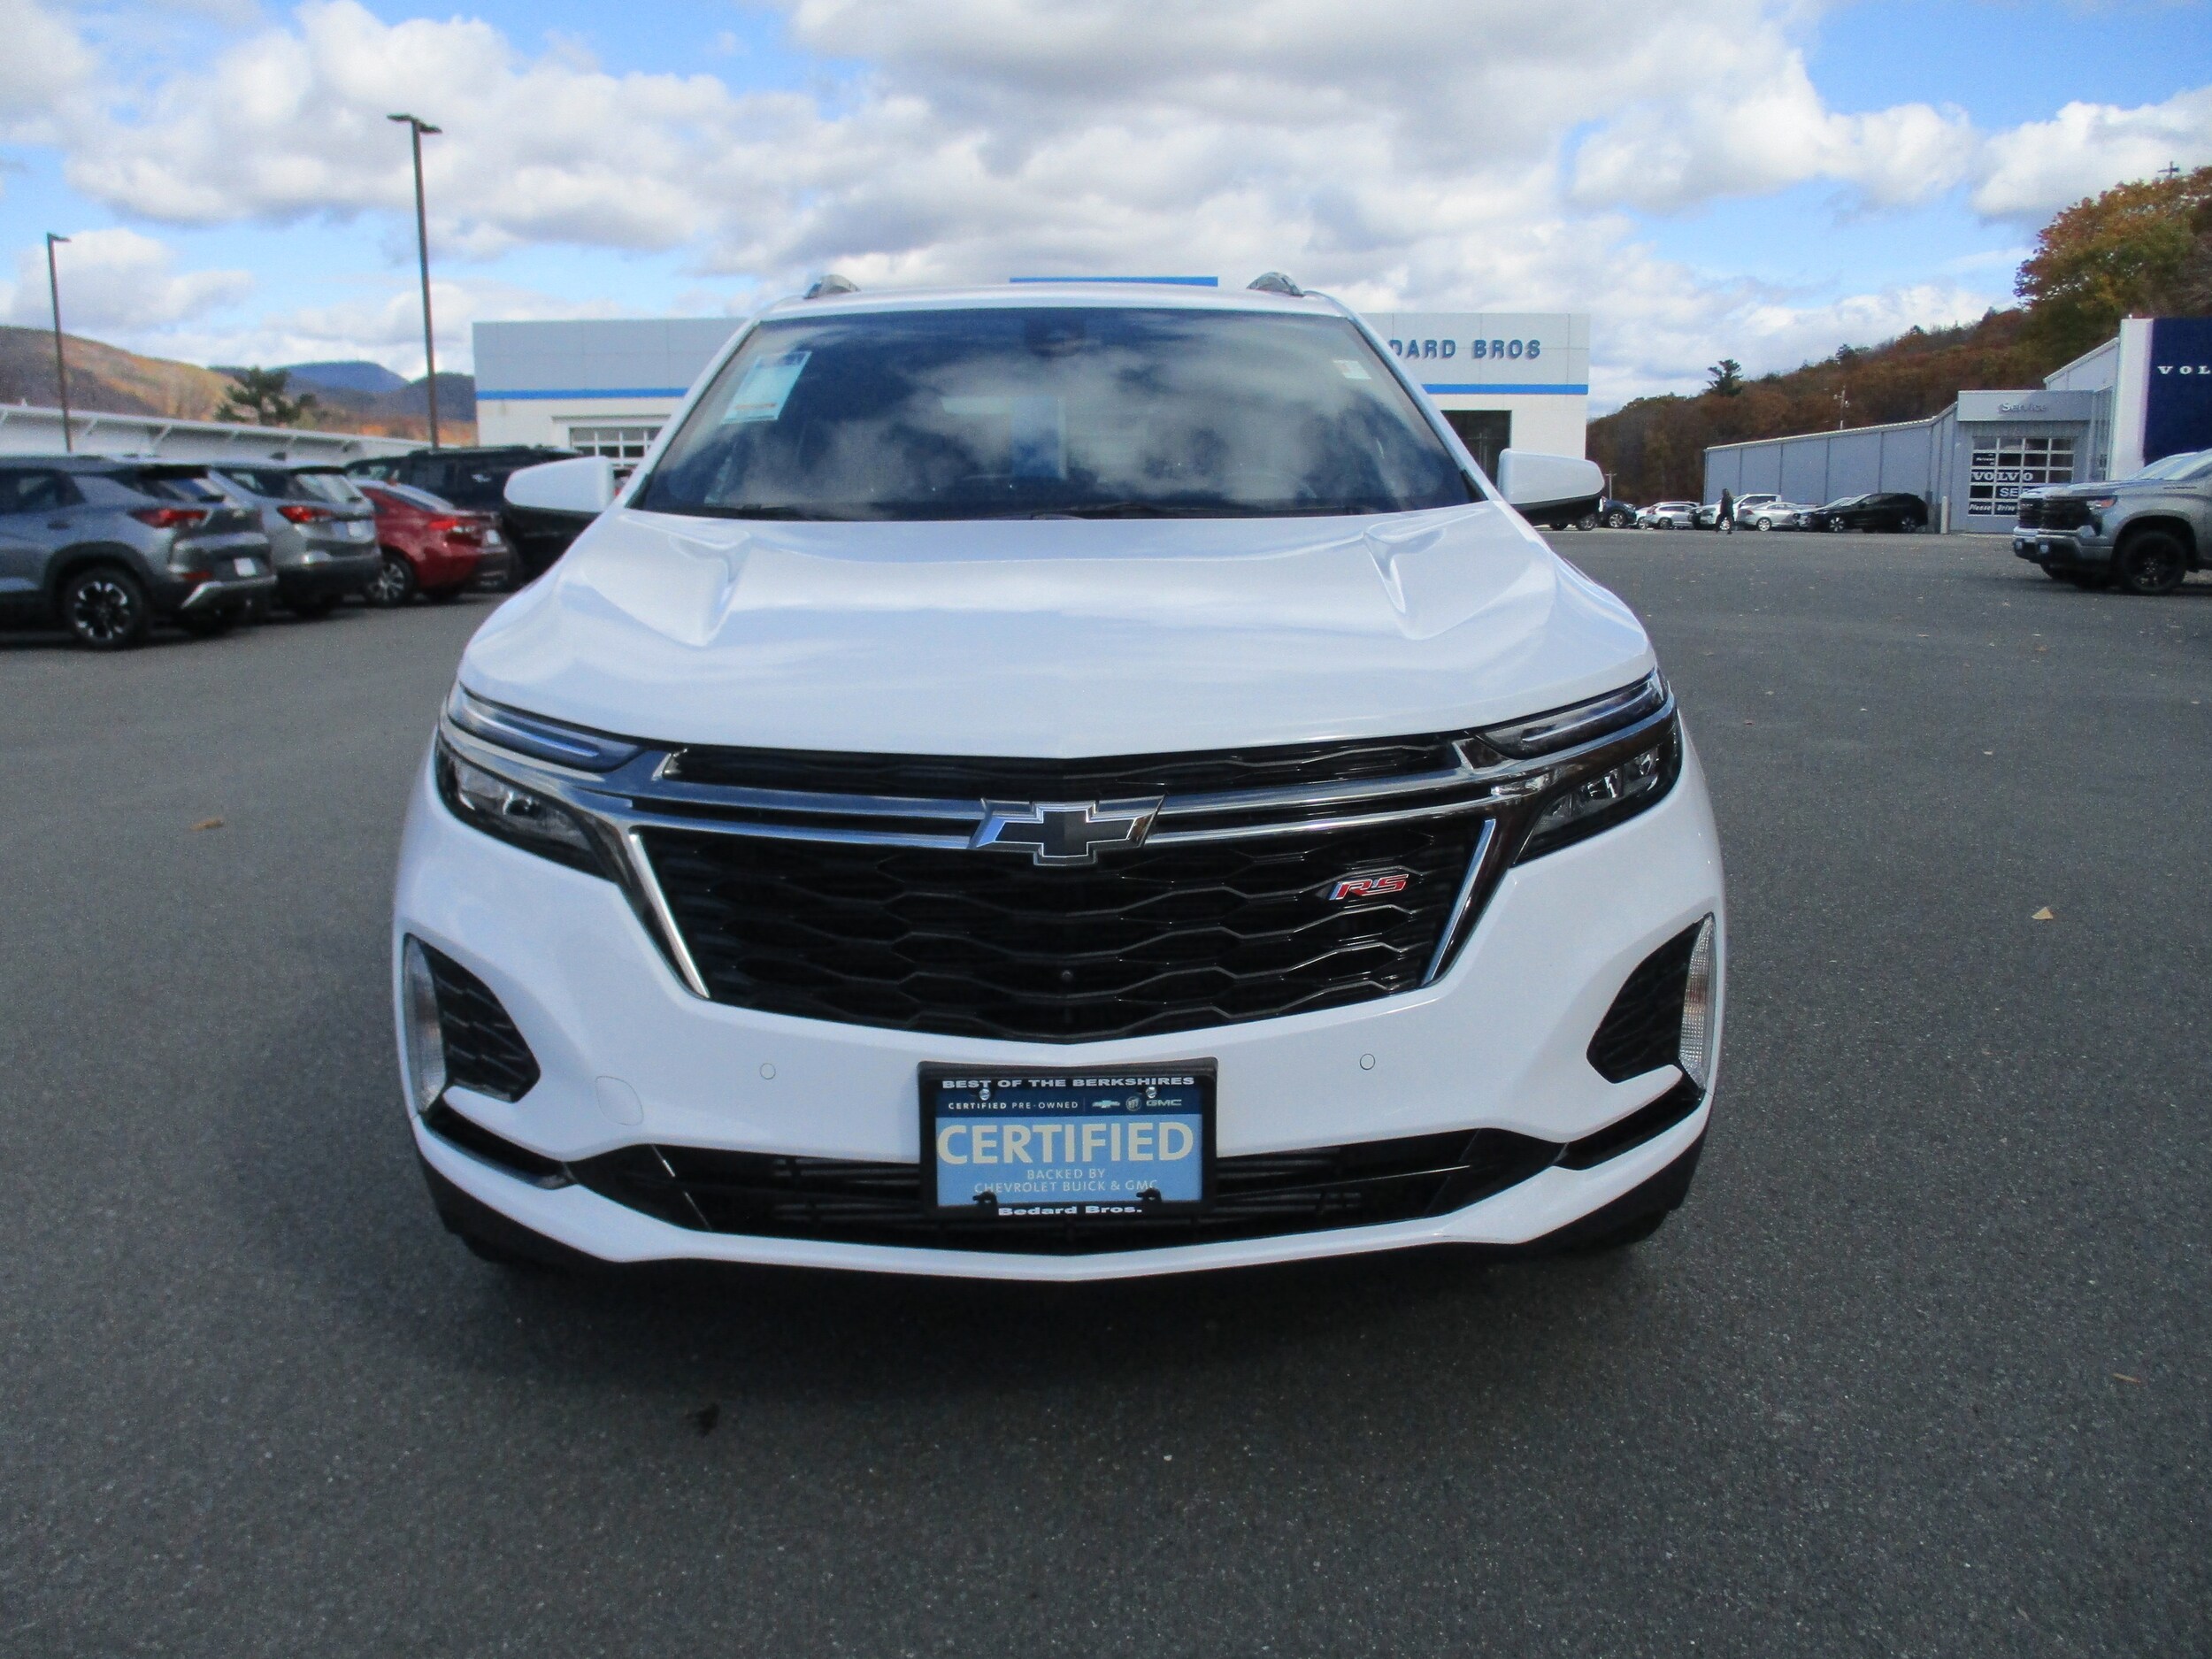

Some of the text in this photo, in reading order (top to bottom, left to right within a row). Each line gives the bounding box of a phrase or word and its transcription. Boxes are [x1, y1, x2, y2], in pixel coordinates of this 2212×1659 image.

[1388, 339, 1541, 359] DARD BROS
[2157, 365, 2211, 375] VOL
[1971, 472, 2034, 481] VOLVO
[1329, 874, 1409, 901] RS
[942, 1077, 1194, 1089] BEST OF THE BERKSHIRES
[1011, 1101, 1079, 1110] PRE-OWNED
[937, 1121, 1194, 1165] CERTIFIED
[1027, 1168, 1106, 1180] BACKED BY
[974, 1181, 1056, 1194] CHEVROLET
[1063, 1180, 1106, 1192] BUICK
[1110, 1180, 1120, 1191] &
[998, 1205, 1142, 1217] Bedard Bros.
